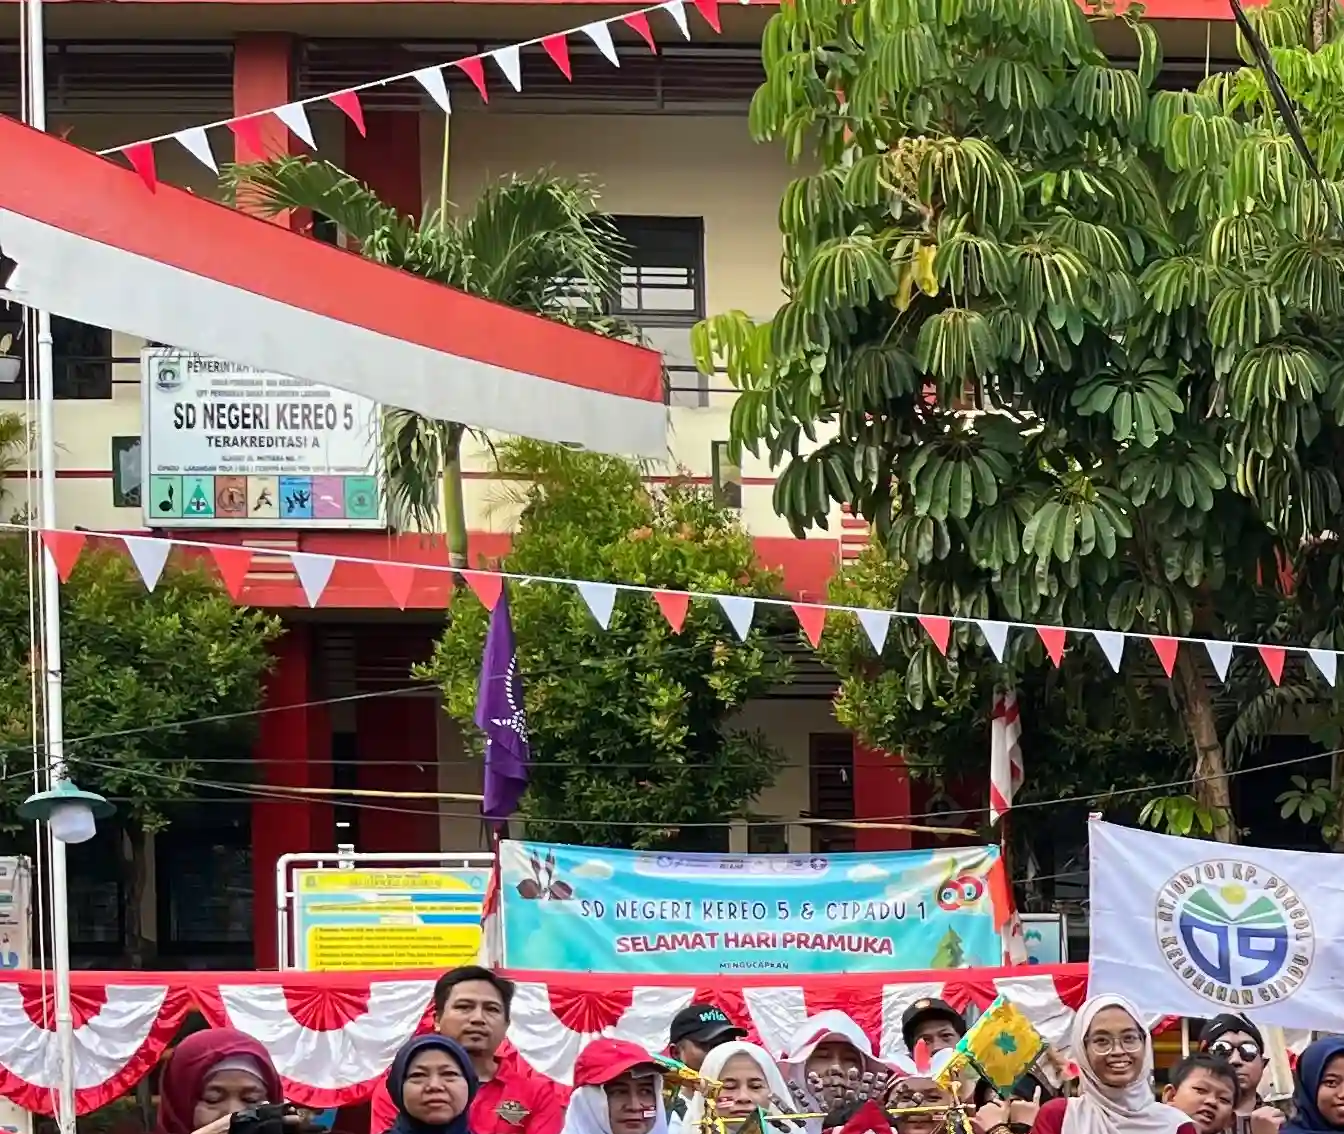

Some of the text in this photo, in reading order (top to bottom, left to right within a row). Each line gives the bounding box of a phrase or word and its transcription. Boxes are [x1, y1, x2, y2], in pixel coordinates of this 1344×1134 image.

[173, 402, 353, 430] SD NEGERI KEREO 5
[206, 435, 320, 448] TERAKREDITASI A
[1232, 862, 1259, 885] KP.
[580, 900, 927, 921] SD NEGERI KEREO 5 & CIPADU 1
[615, 931, 894, 955] SELAMAT HARI PRAMUKA
[1180, 910, 1289, 987] 09
[719, 962, 790, 970] MENGUCAPKAN
[1160, 935, 1309, 1005] KELURAHAN CIPADU
